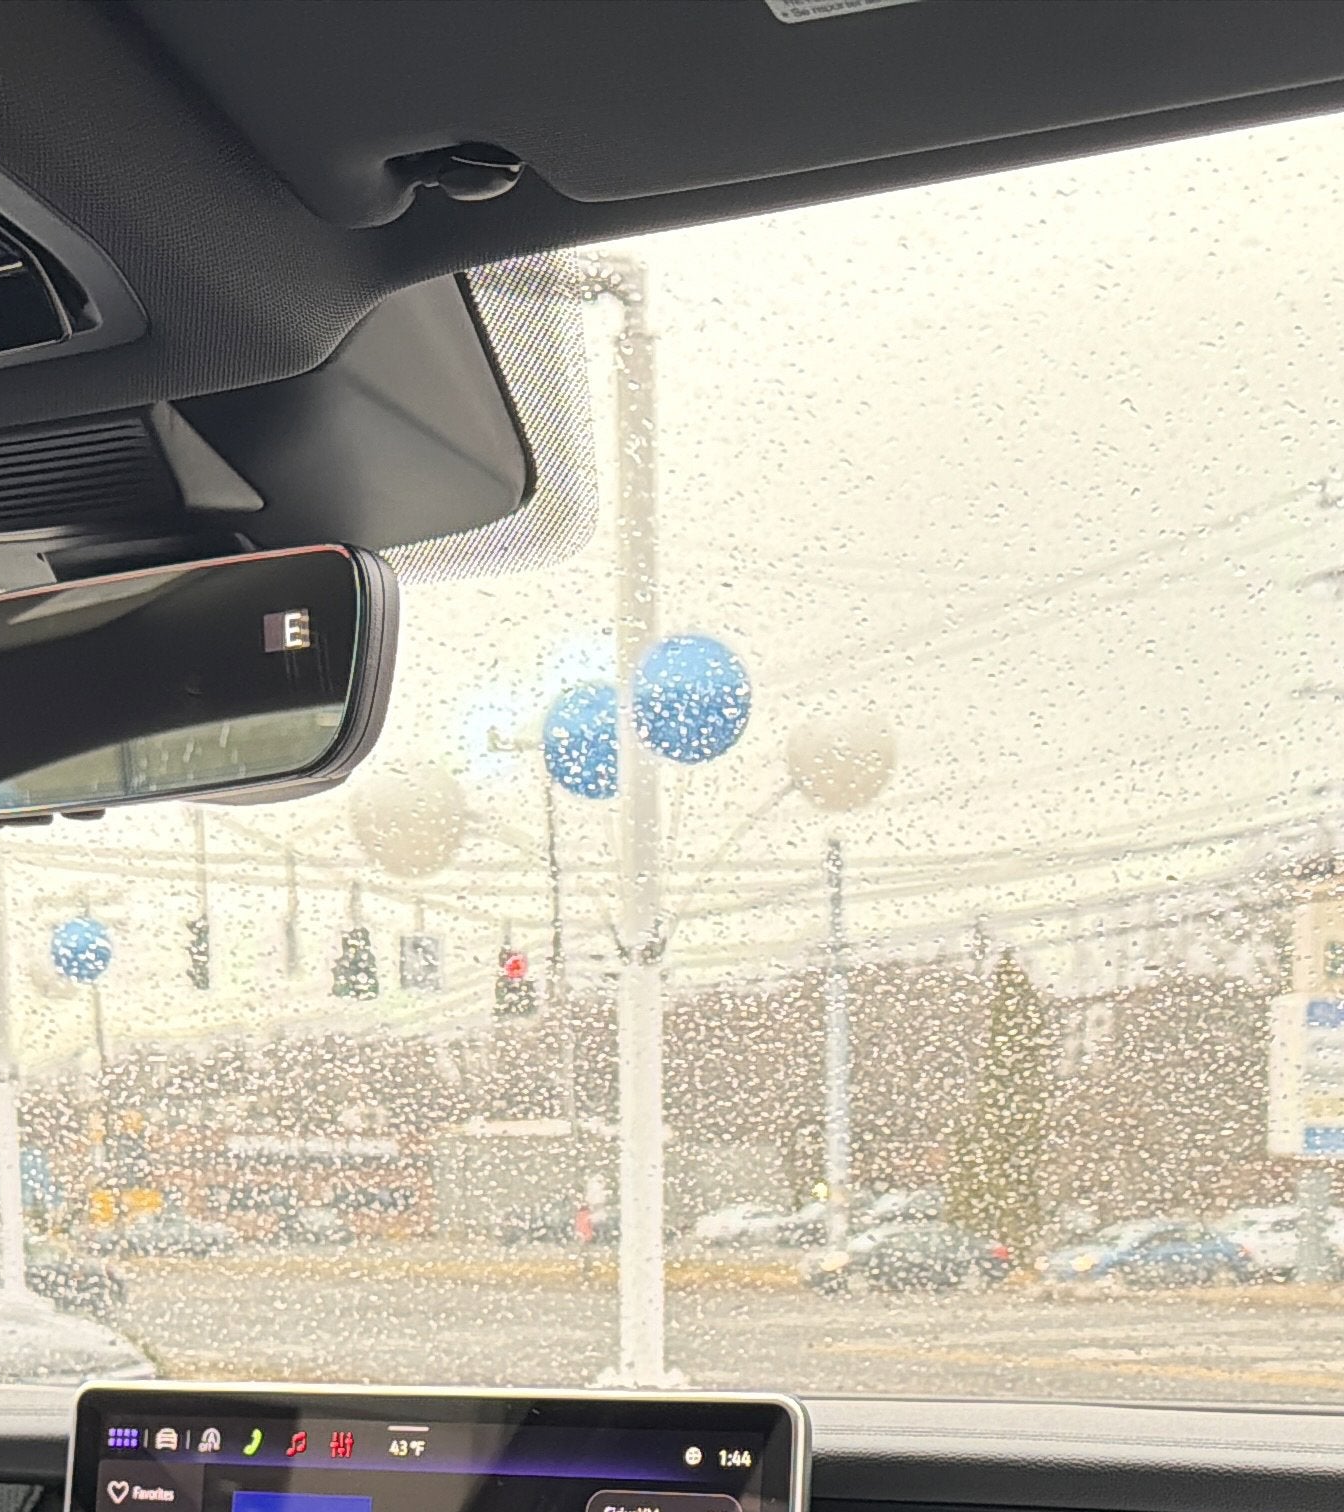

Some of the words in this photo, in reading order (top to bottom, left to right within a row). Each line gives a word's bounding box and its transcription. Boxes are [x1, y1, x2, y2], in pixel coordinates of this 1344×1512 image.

[389, 1440, 408, 1456] 43
[718, 1449, 752, 1467] 1:44
[132, 1486, 175, 1502] Favorites
